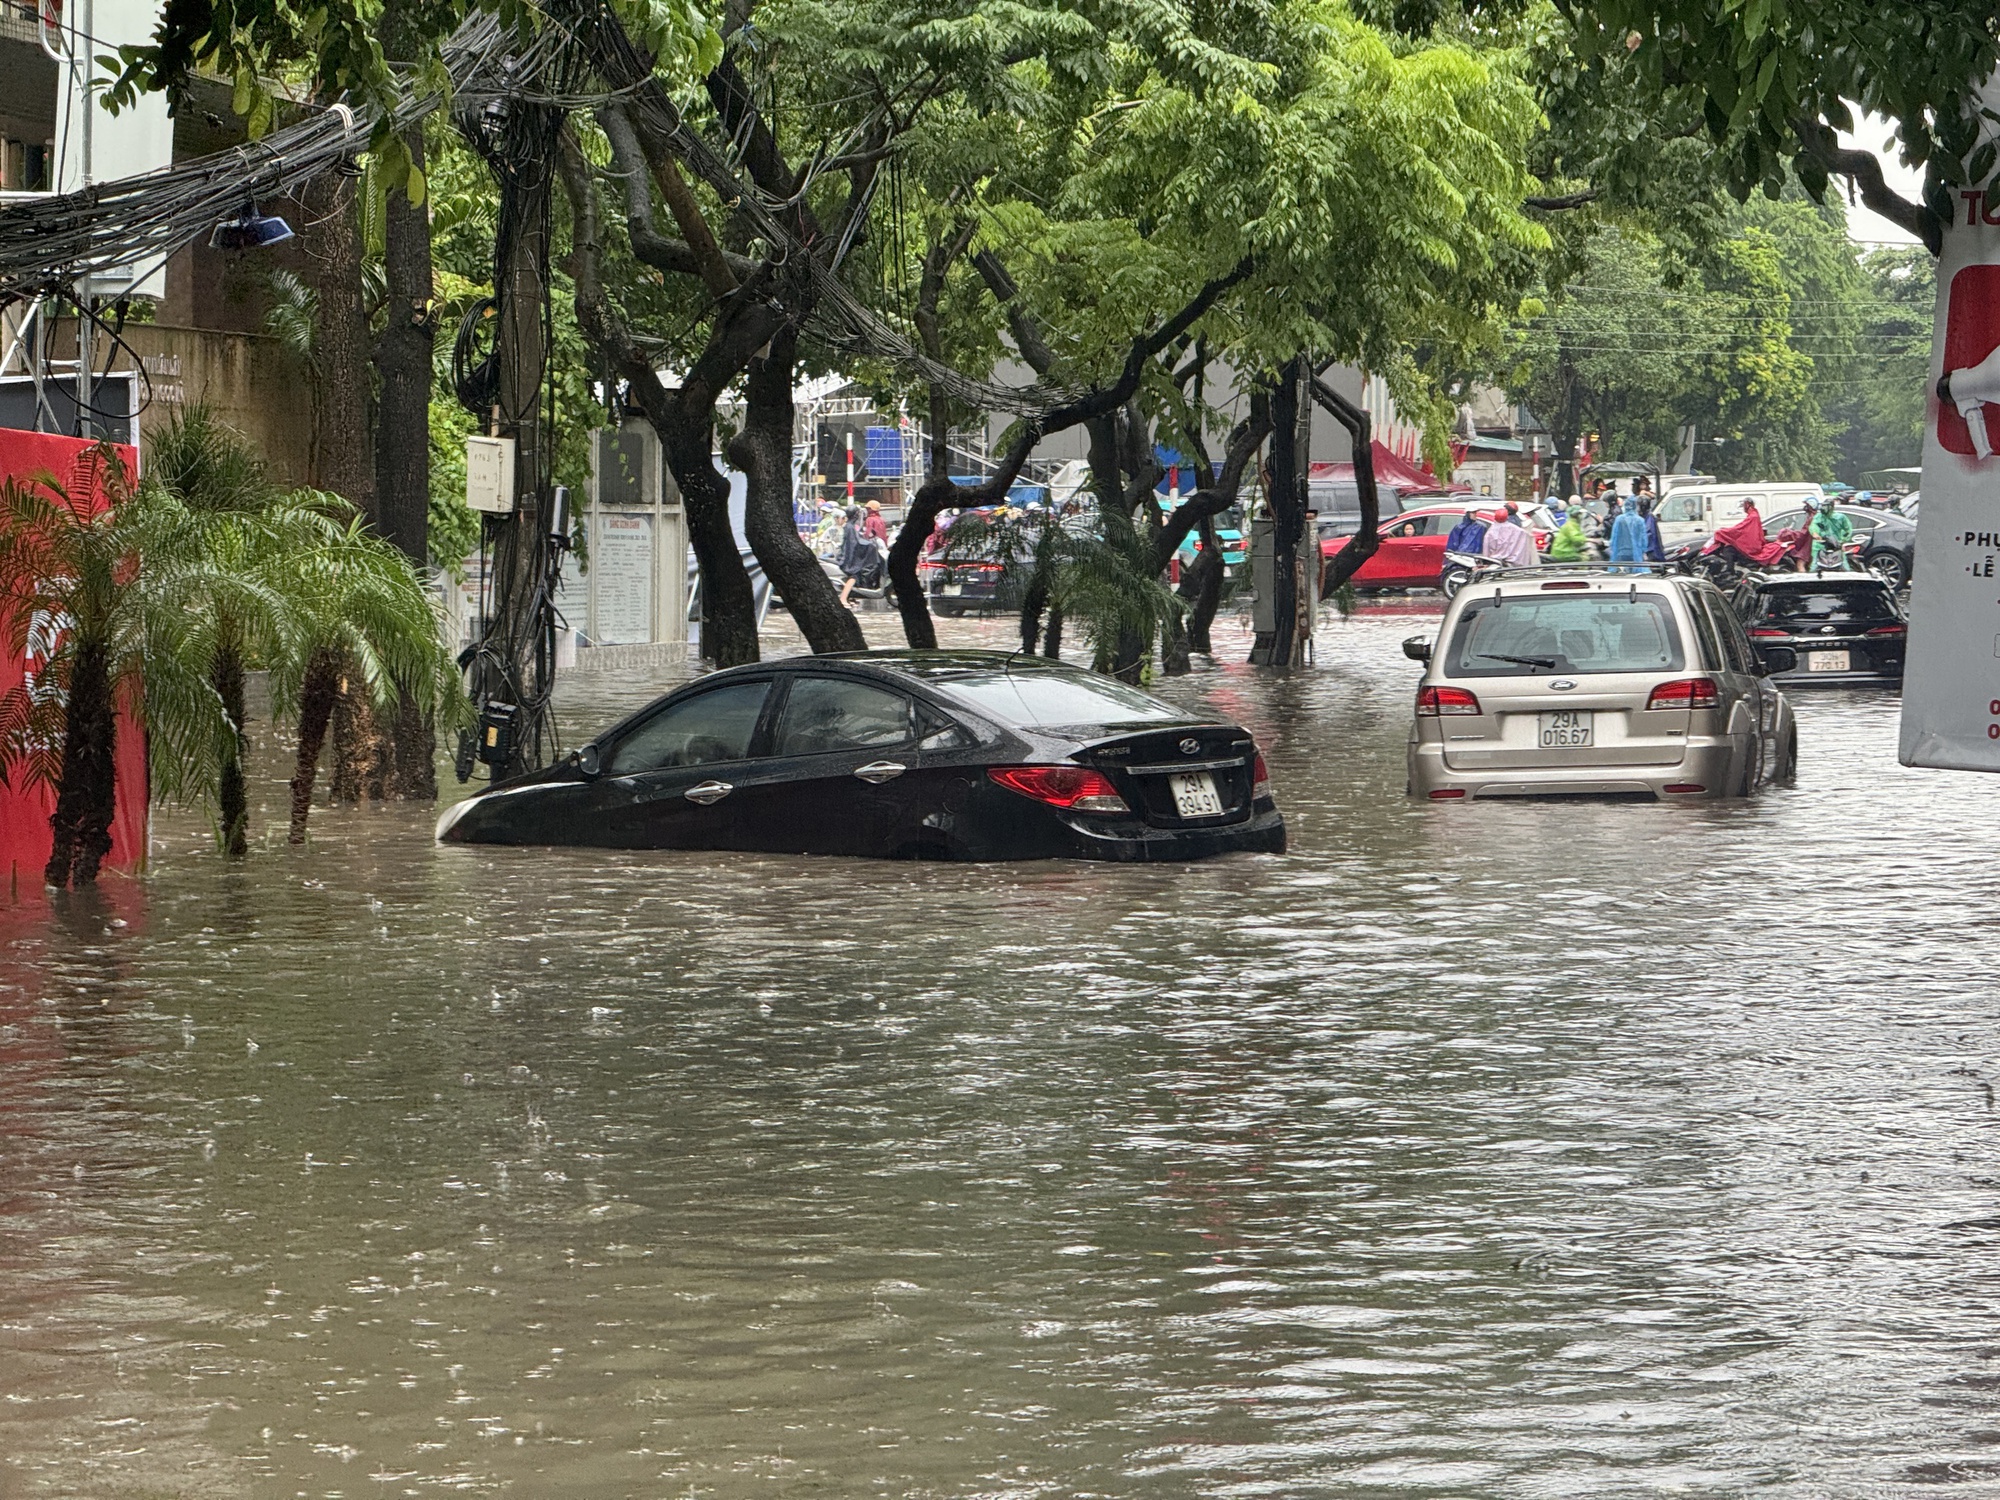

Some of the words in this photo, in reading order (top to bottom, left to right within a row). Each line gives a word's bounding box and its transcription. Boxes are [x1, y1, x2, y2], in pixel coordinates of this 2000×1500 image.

[1973, 555, 1995, 578] LỄ
[1552, 711, 1580, 729] 29A
[1543, 728, 1590, 746] 016.67
[1180, 774, 1206, 794] 29A
